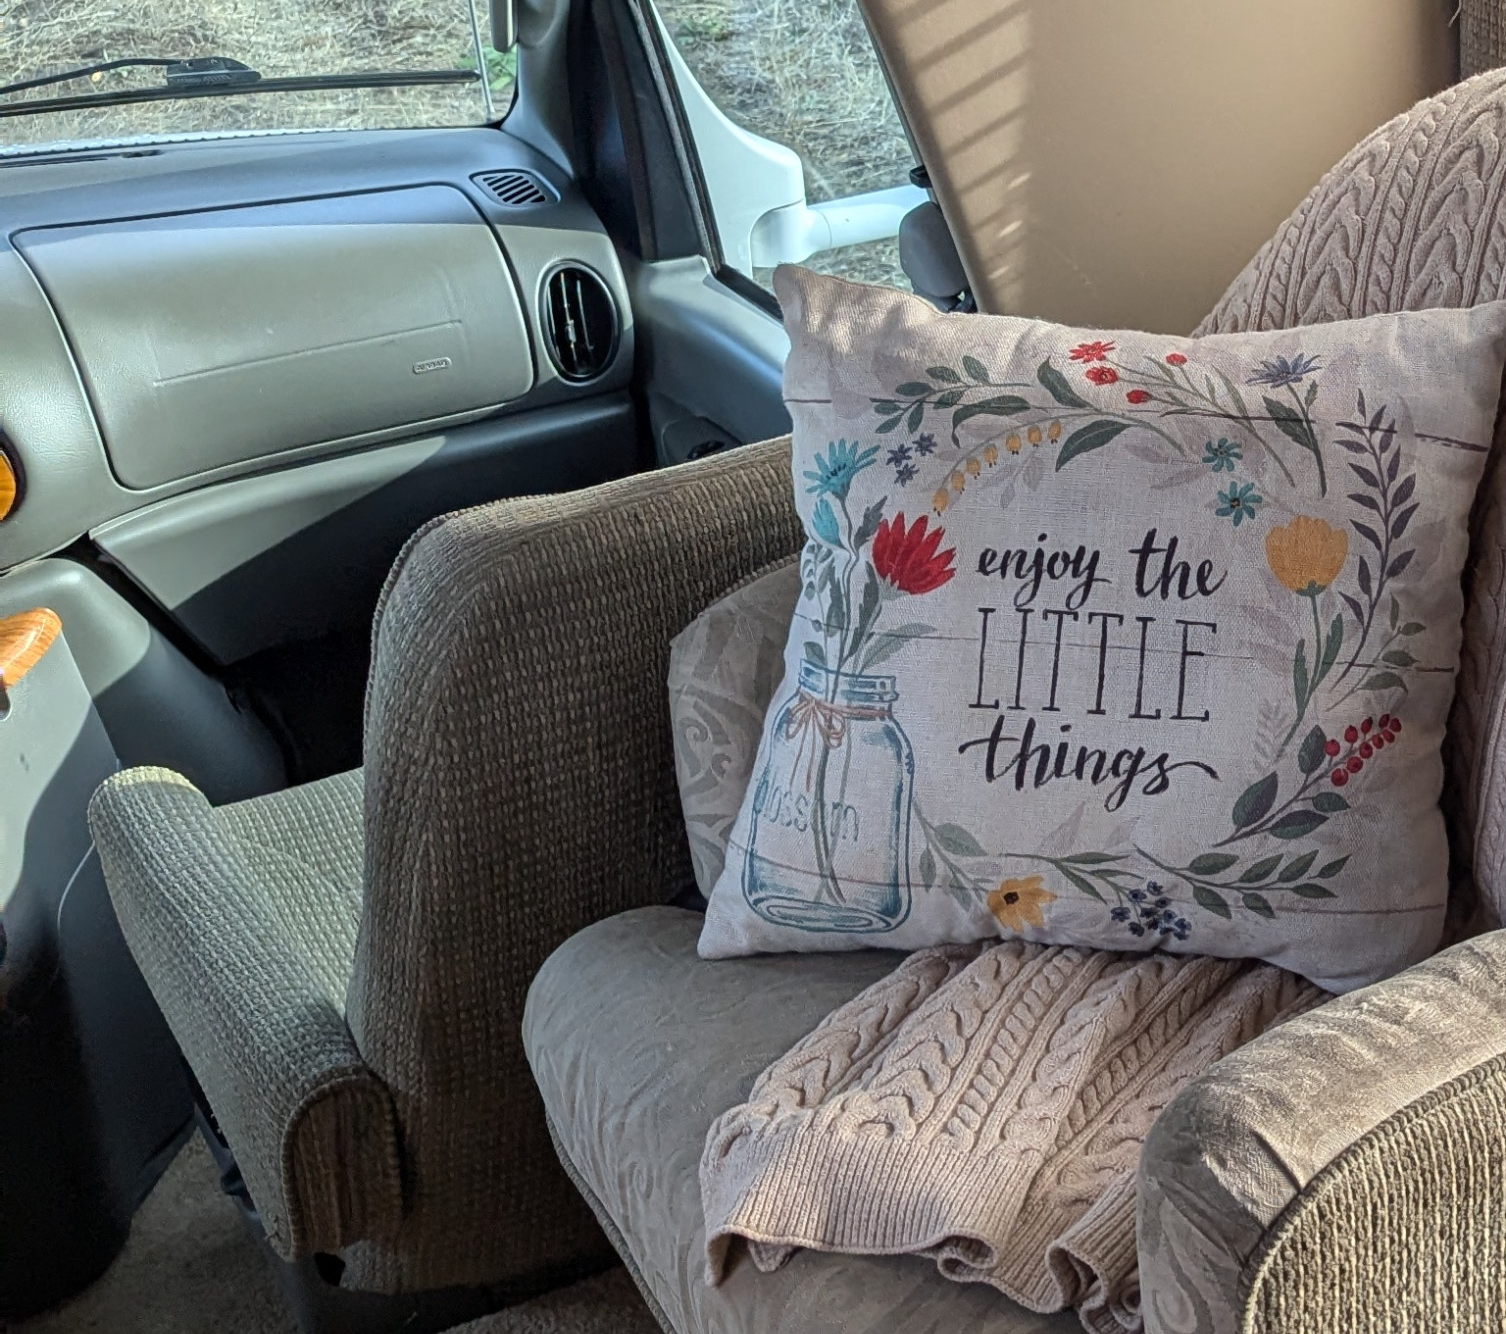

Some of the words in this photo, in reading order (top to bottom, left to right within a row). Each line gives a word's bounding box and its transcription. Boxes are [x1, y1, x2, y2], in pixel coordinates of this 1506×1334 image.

[975, 534, 1113, 609] enjoy
[1128, 528, 1228, 599] the
[967, 605, 1218, 721] LITTLE
[958, 714, 1219, 812] things
